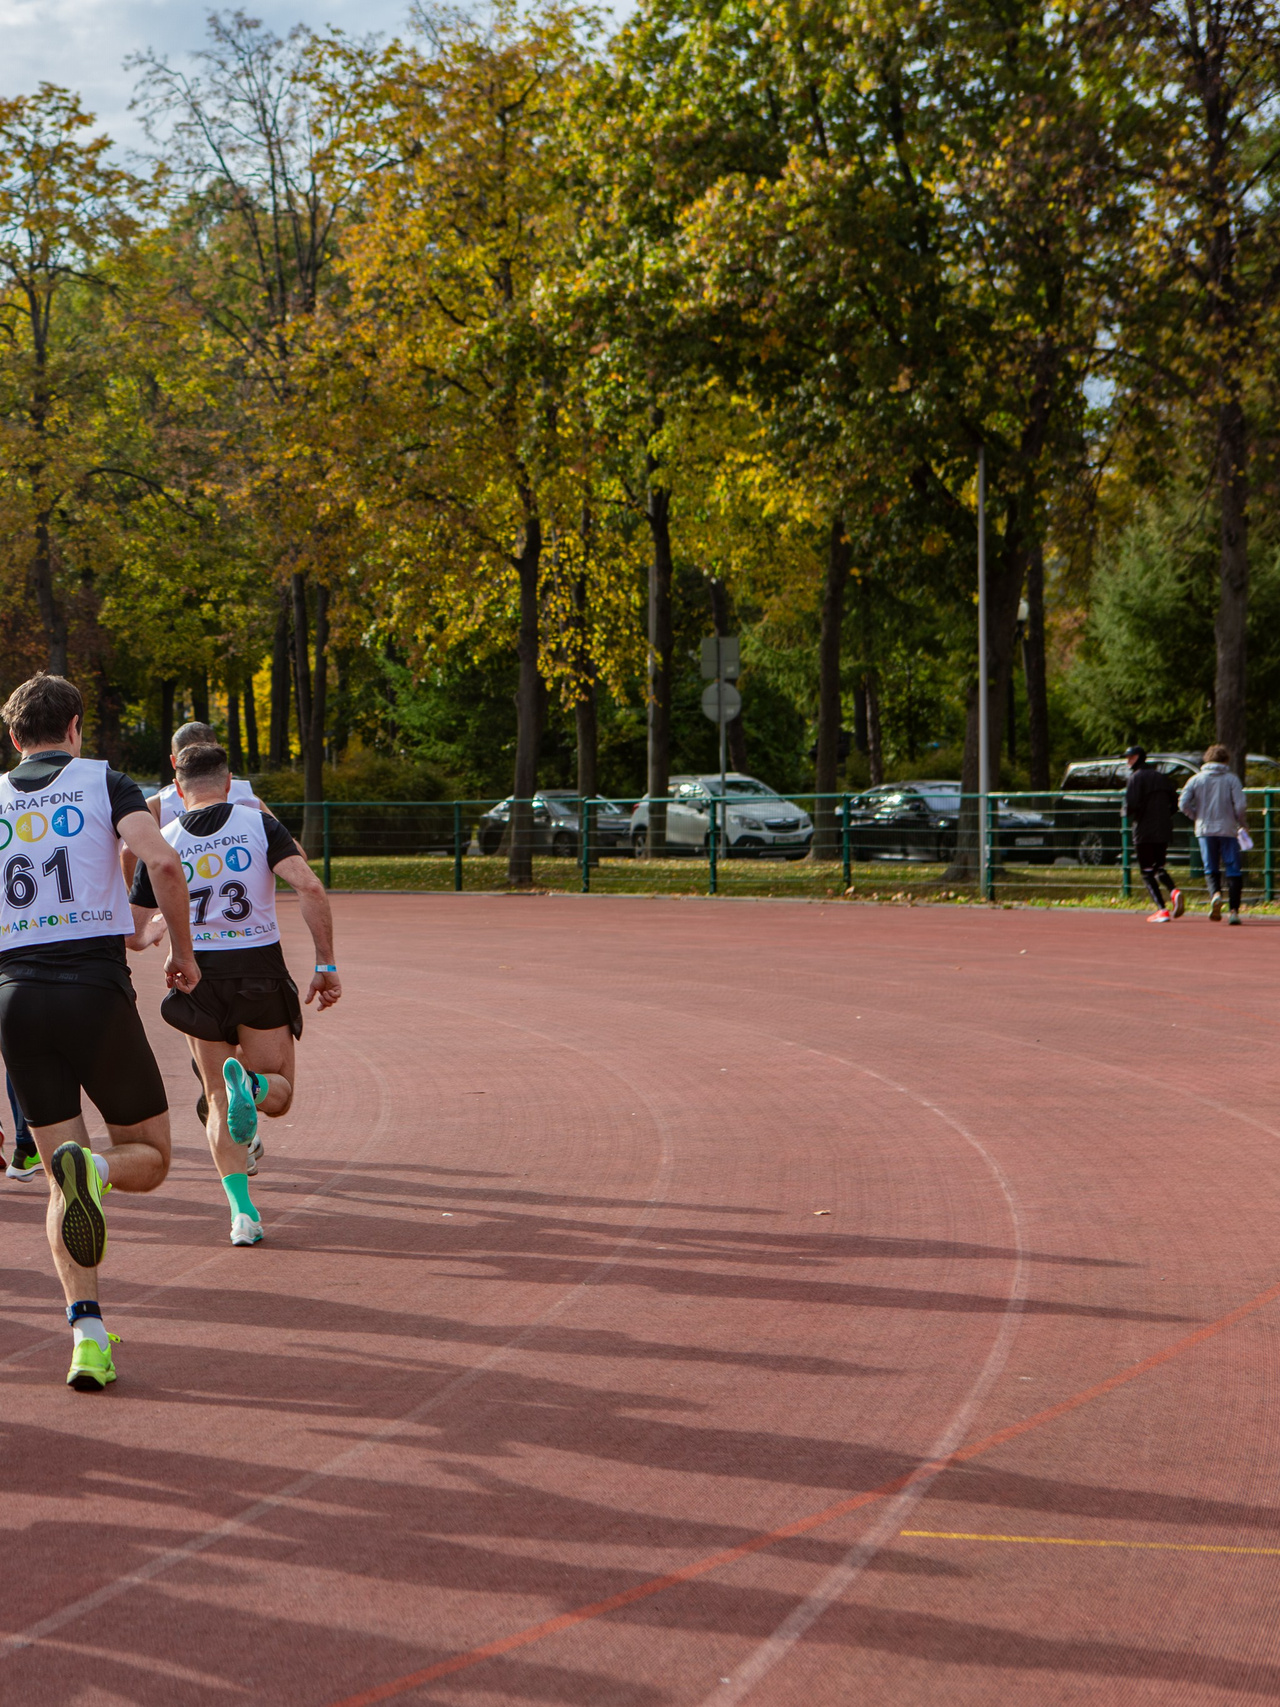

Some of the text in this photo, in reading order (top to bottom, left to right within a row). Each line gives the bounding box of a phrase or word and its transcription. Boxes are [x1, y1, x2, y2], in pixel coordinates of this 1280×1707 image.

[179, 834, 249, 858] MARAFONE
[3, 846, 74, 909] 61
[189, 879, 253, 926] 73
[192, 921, 276, 941] ARAFONE.CLUB
